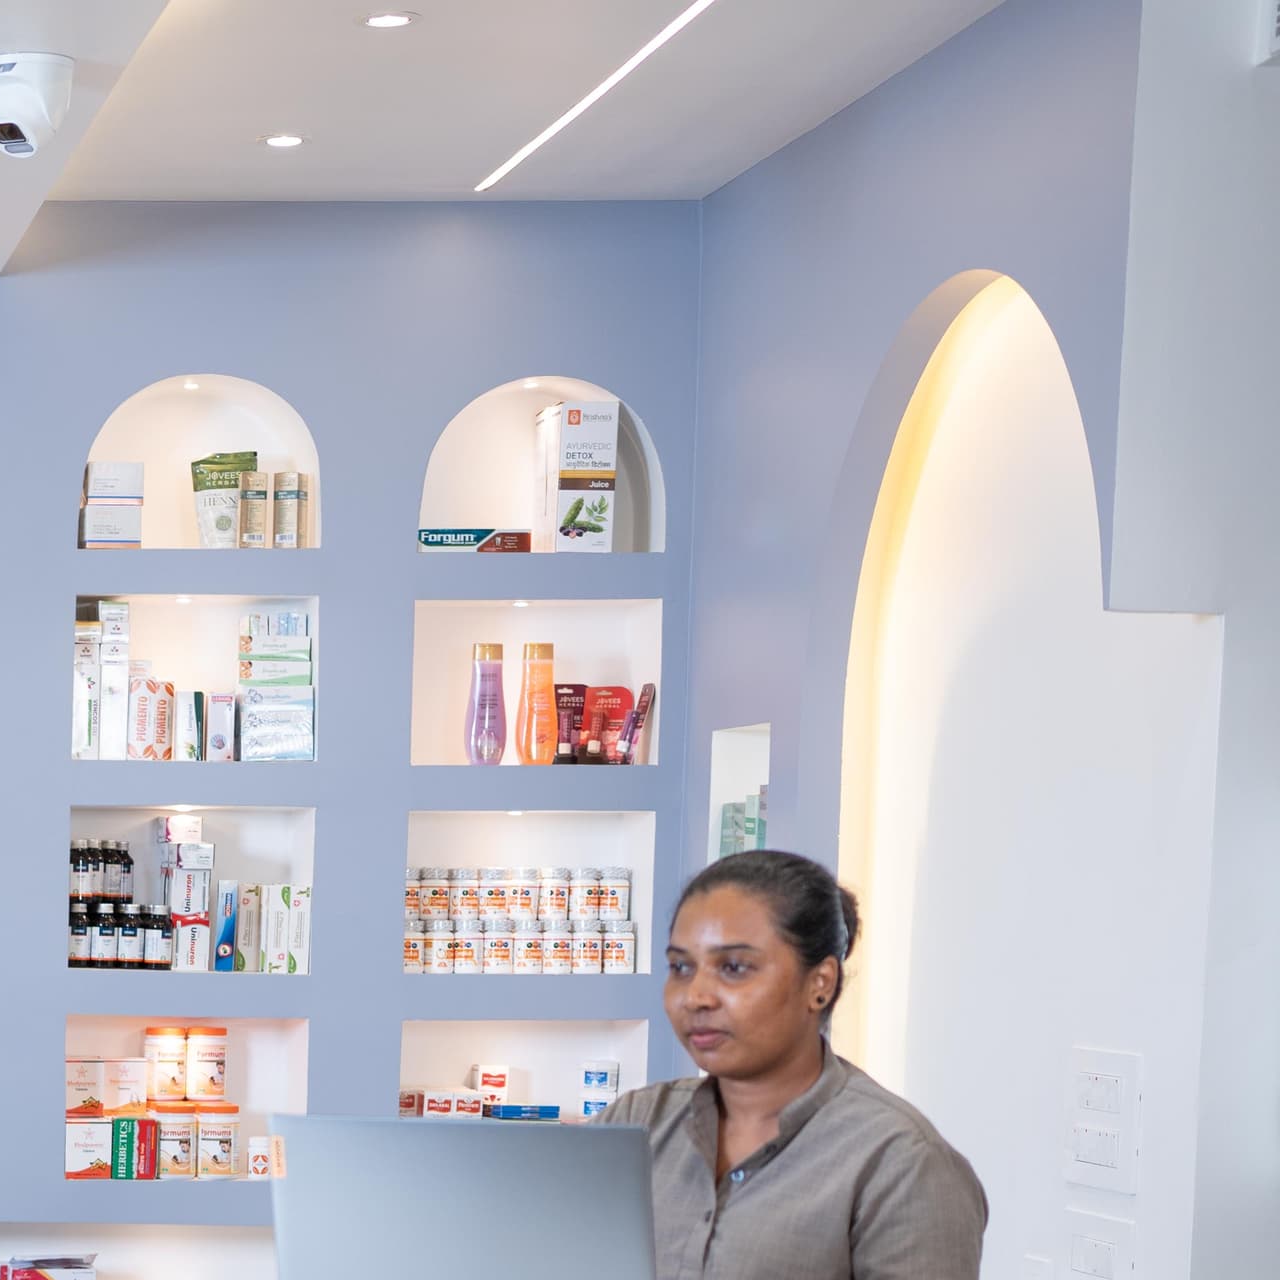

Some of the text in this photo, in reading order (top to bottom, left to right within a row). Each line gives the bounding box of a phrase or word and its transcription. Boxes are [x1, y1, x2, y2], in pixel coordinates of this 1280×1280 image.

[566, 442, 612, 450] AYURVEDIC
[205, 472, 240, 481] JOVEES
[589, 480, 610, 488] Juice
[202, 495, 240, 508] HENN
[421, 531, 475, 545] Forgum
[136, 696, 148, 742] PIGMENTO
[156, 699, 167, 744] PIGMENTO
[184, 874, 193, 913] Uninuron
[188, 927, 197, 966] Uninuron
[118, 1121, 128, 1178] HERBETICS
